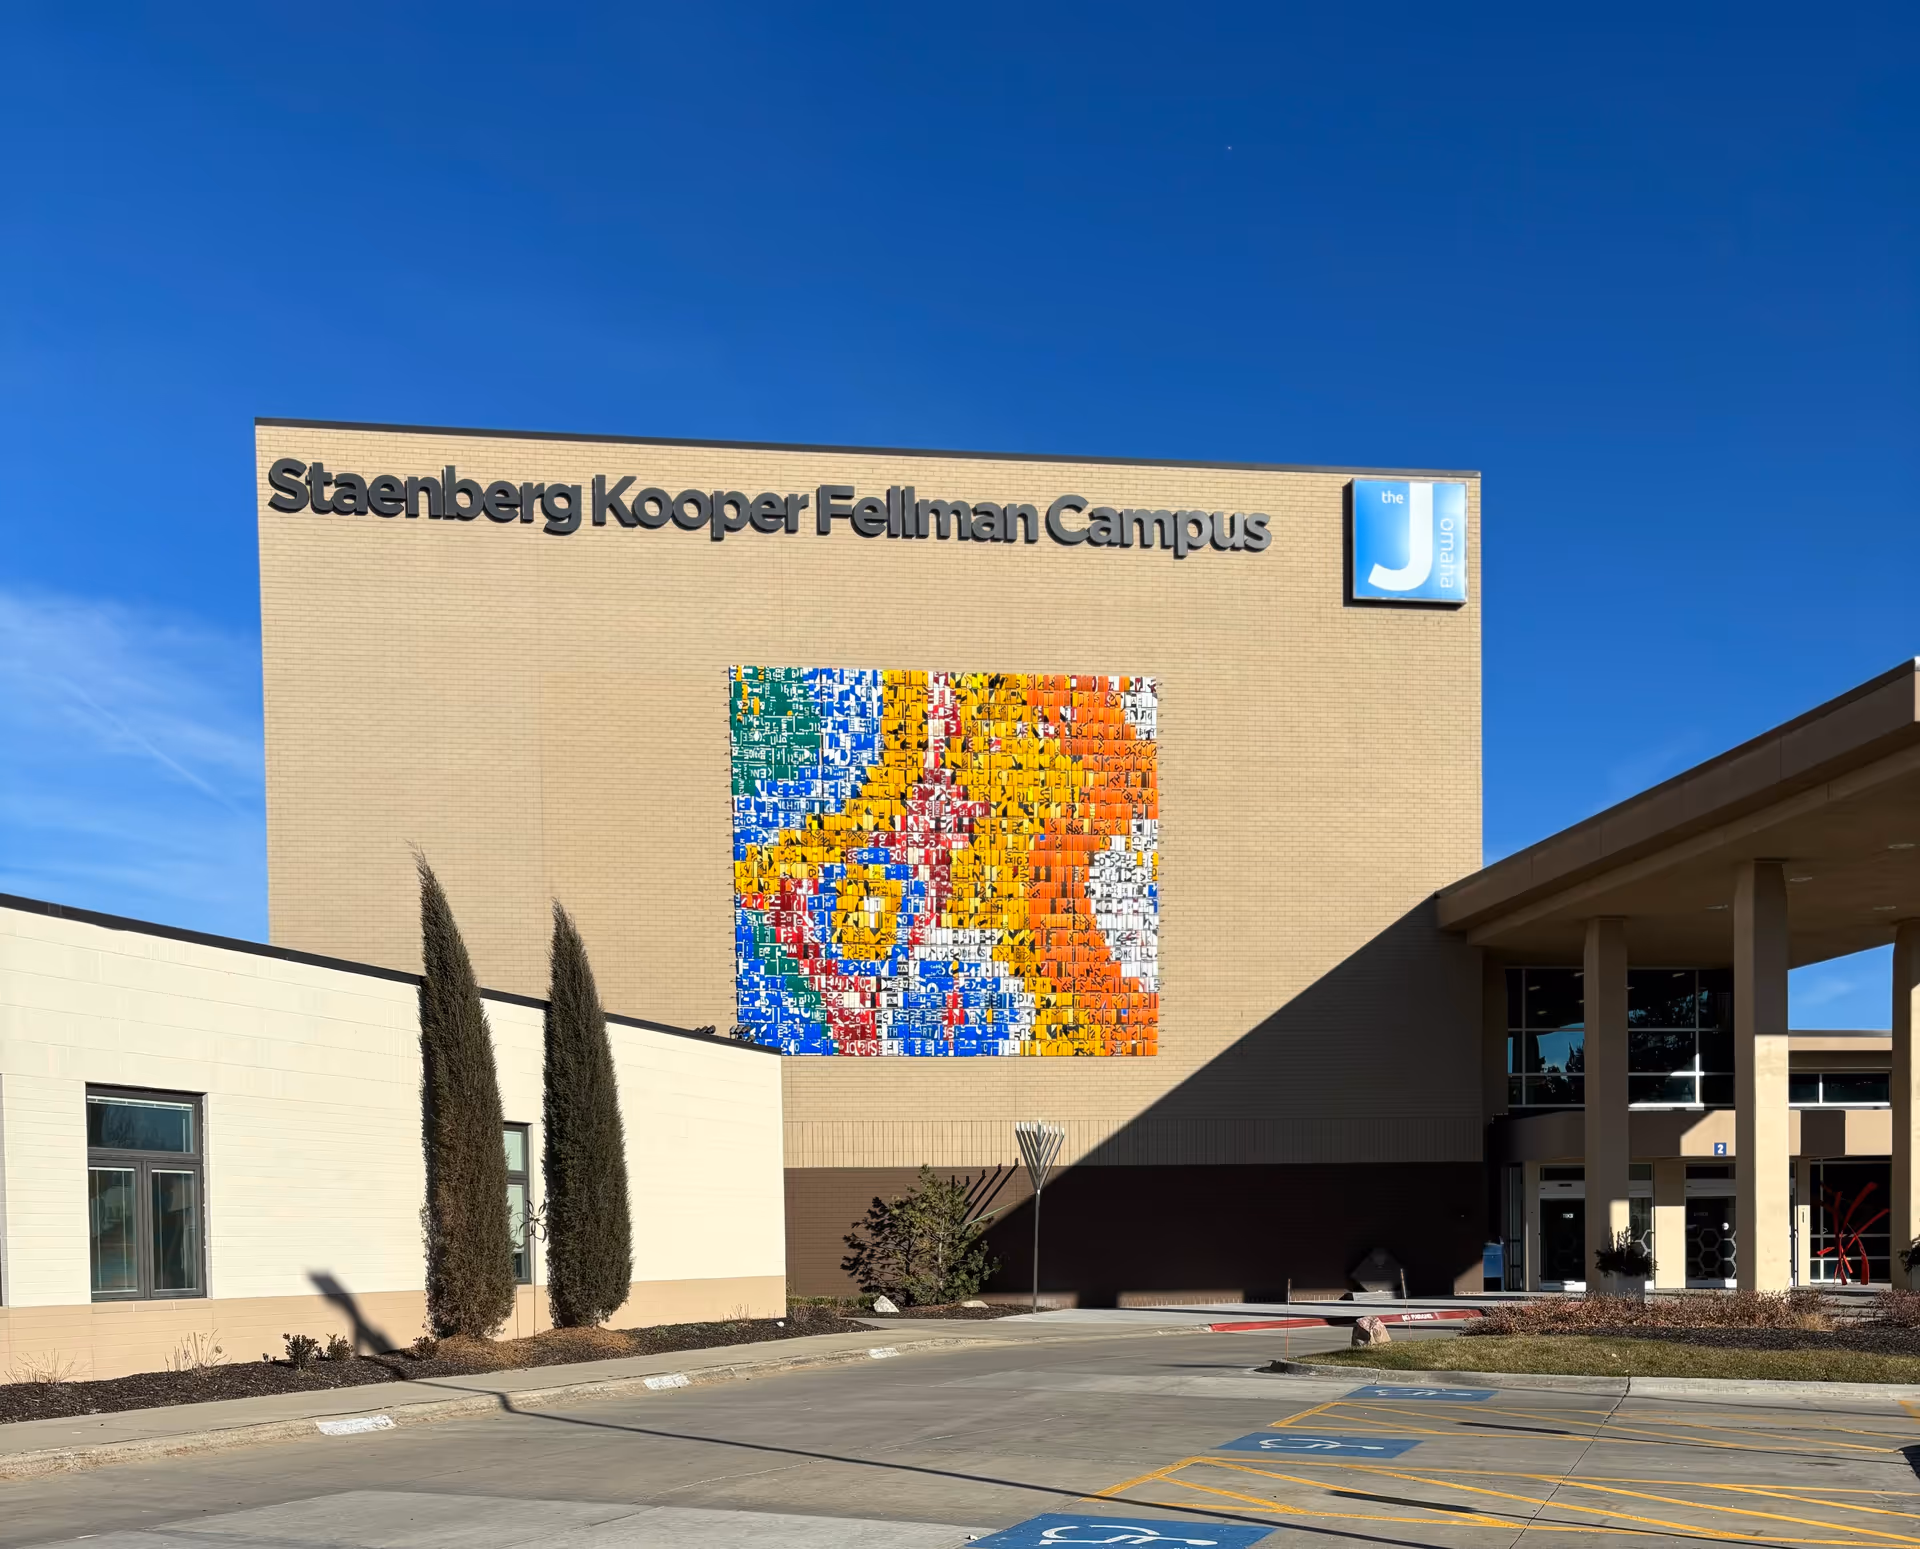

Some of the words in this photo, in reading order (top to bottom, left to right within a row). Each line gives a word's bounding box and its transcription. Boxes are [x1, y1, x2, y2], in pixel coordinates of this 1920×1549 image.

[268, 458, 582, 535] Staenberg
[592, 473, 809, 541] Kooper
[816, 484, 1039, 543] Fellman
[1046, 494, 1272, 560] Campus
[1381, 490, 1404, 504] the
[1368, 482, 1434, 592] J
[1440, 517, 1454, 589] omaha
[1717, 1144, 1724, 1154] 2
